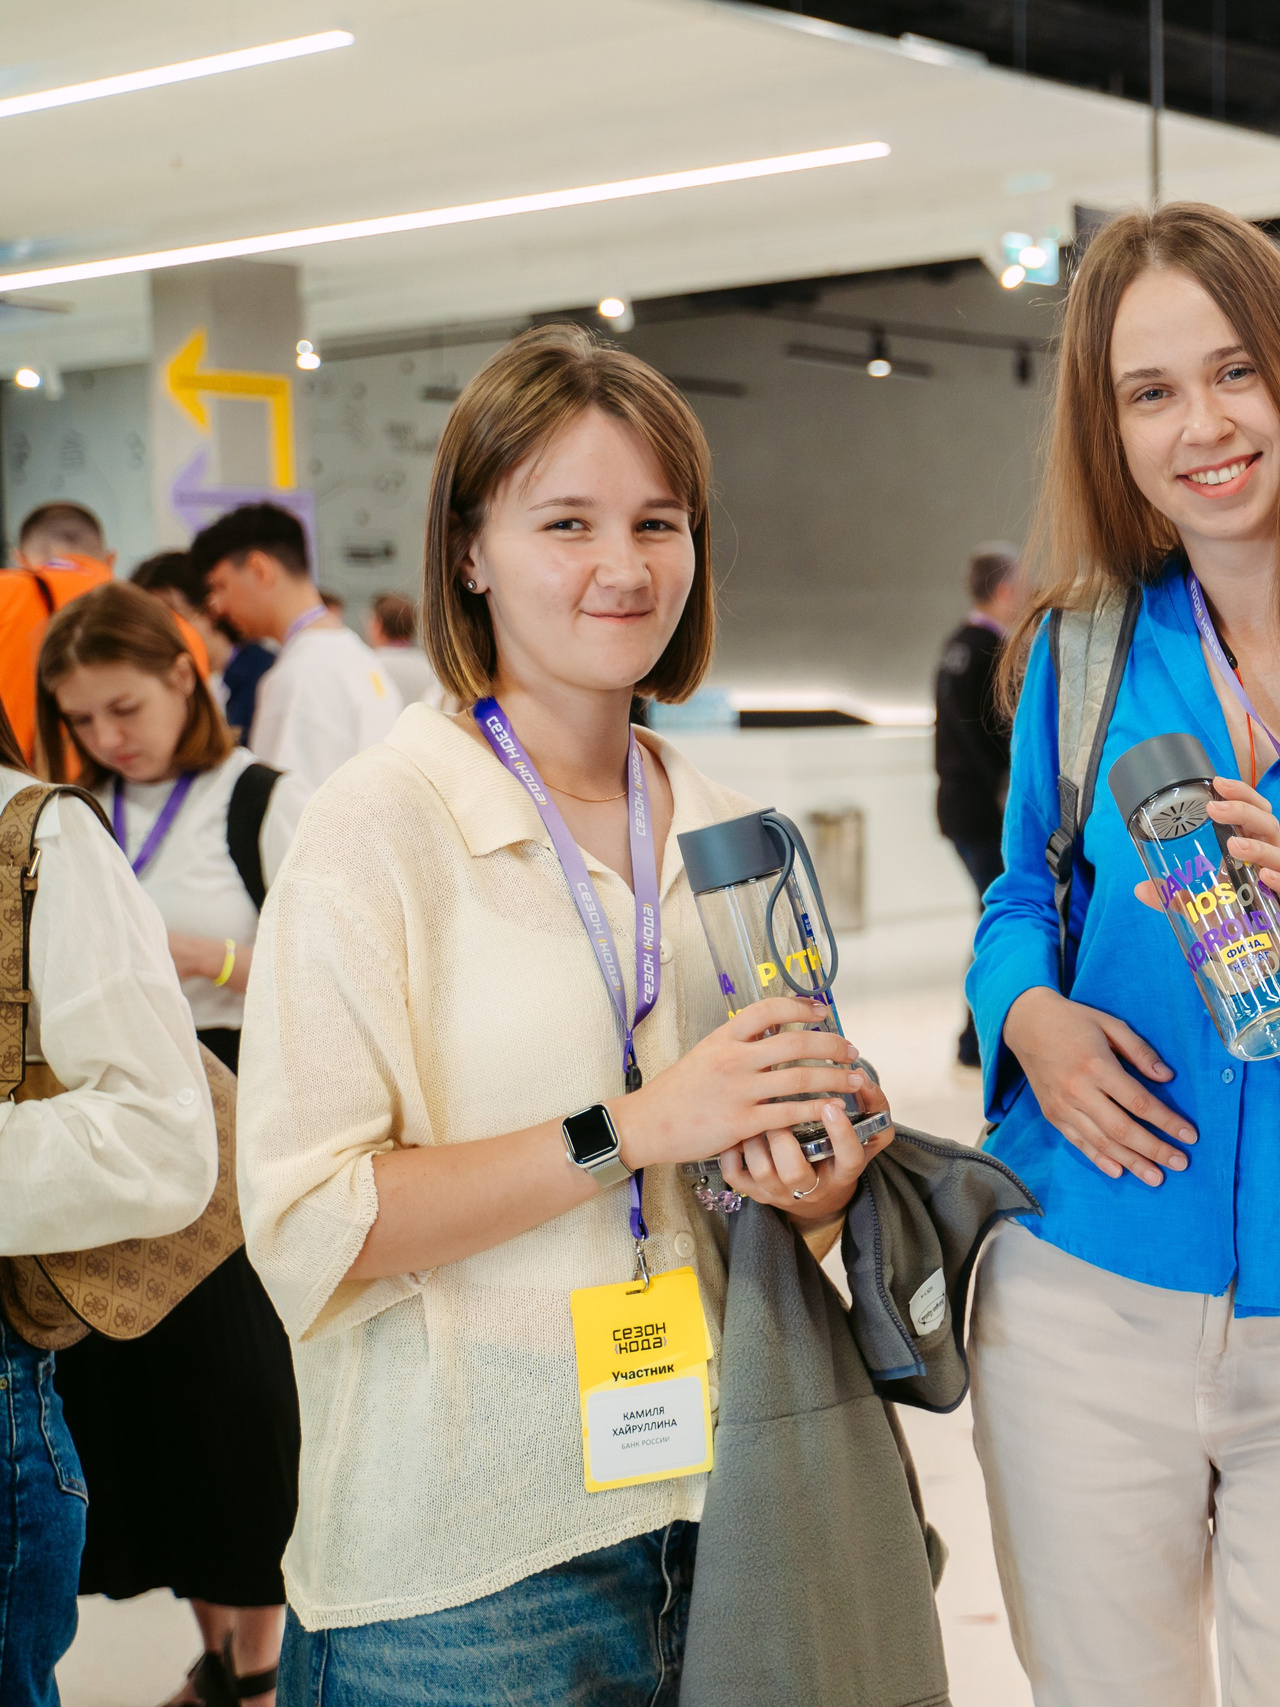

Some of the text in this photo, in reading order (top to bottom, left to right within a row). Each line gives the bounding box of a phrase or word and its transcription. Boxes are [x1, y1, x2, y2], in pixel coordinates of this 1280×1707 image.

[1159, 854, 1216, 909] JAVA
[612, 1322, 667, 1342] сезон
[612, 1363, 675, 1382] Участник
[623, 1406, 665, 1421] КАМИЛЯ
[612, 1418, 678, 1437] ХАЙРУЛЛИНА
[621, 1436, 671, 1450] БАНК РОССИИ
